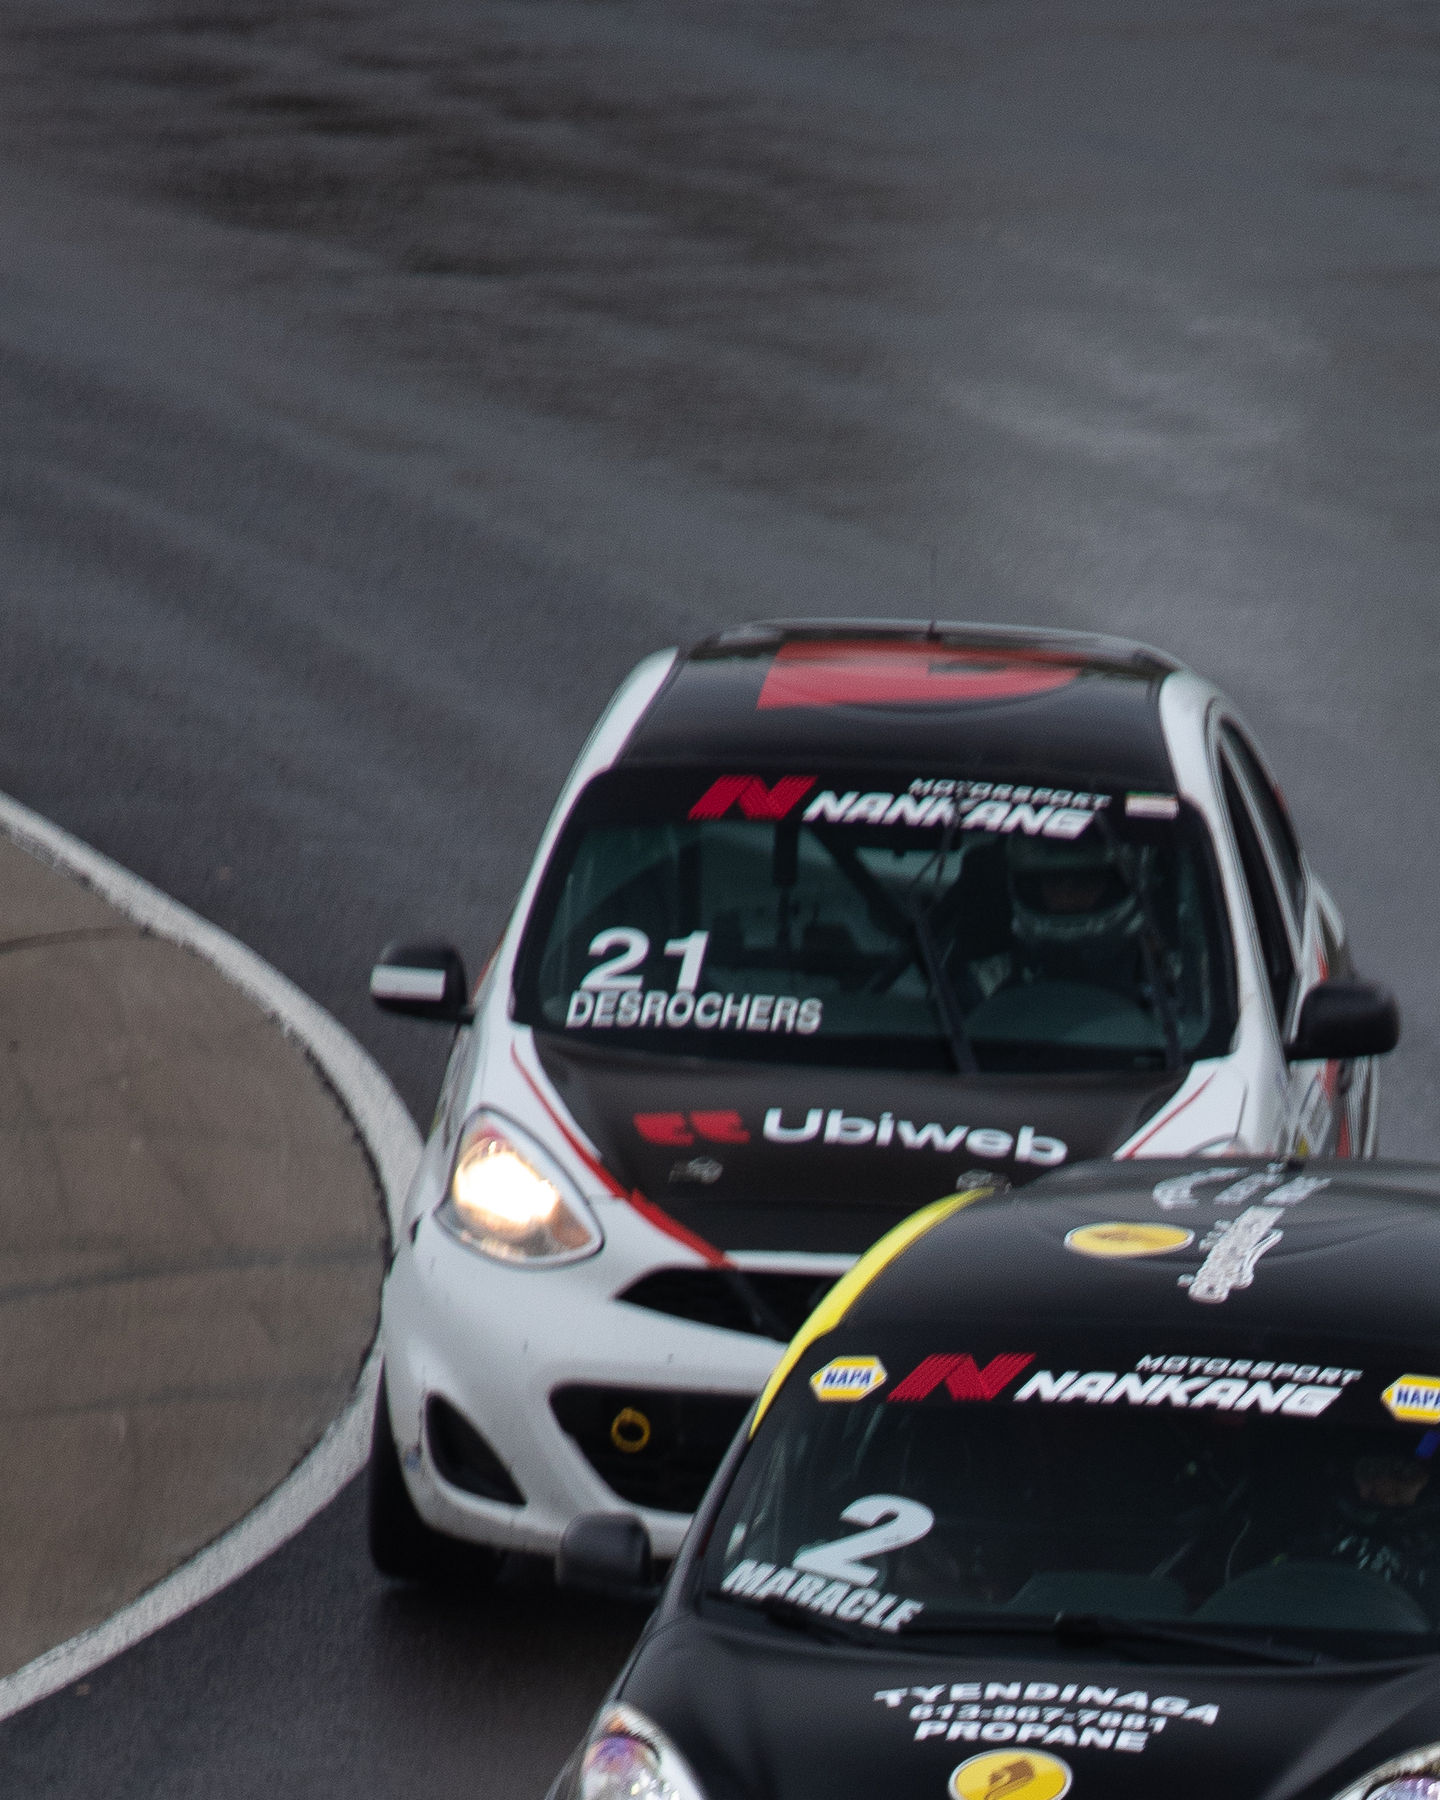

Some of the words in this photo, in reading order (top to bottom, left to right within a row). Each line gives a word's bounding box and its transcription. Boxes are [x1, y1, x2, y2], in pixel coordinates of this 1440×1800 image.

[802, 790, 1094, 839] NANKANG
[907, 777, 1112, 809] MOTORSPORT
[580, 925, 710, 992] 21
[565, 989, 823, 1034] DESROCHERS
[762, 1108, 1068, 1165] Ubiweb
[824, 1368, 872, 1386] NAPA
[1136, 1354, 1363, 1386] MOTORSPORT
[1013, 1370, 1343, 1418] NANKANG
[792, 1494, 935, 1588] 2
[874, 1682, 1220, 1726] TYENDINAGA
[914, 1720, 1150, 1753] PROPANE
